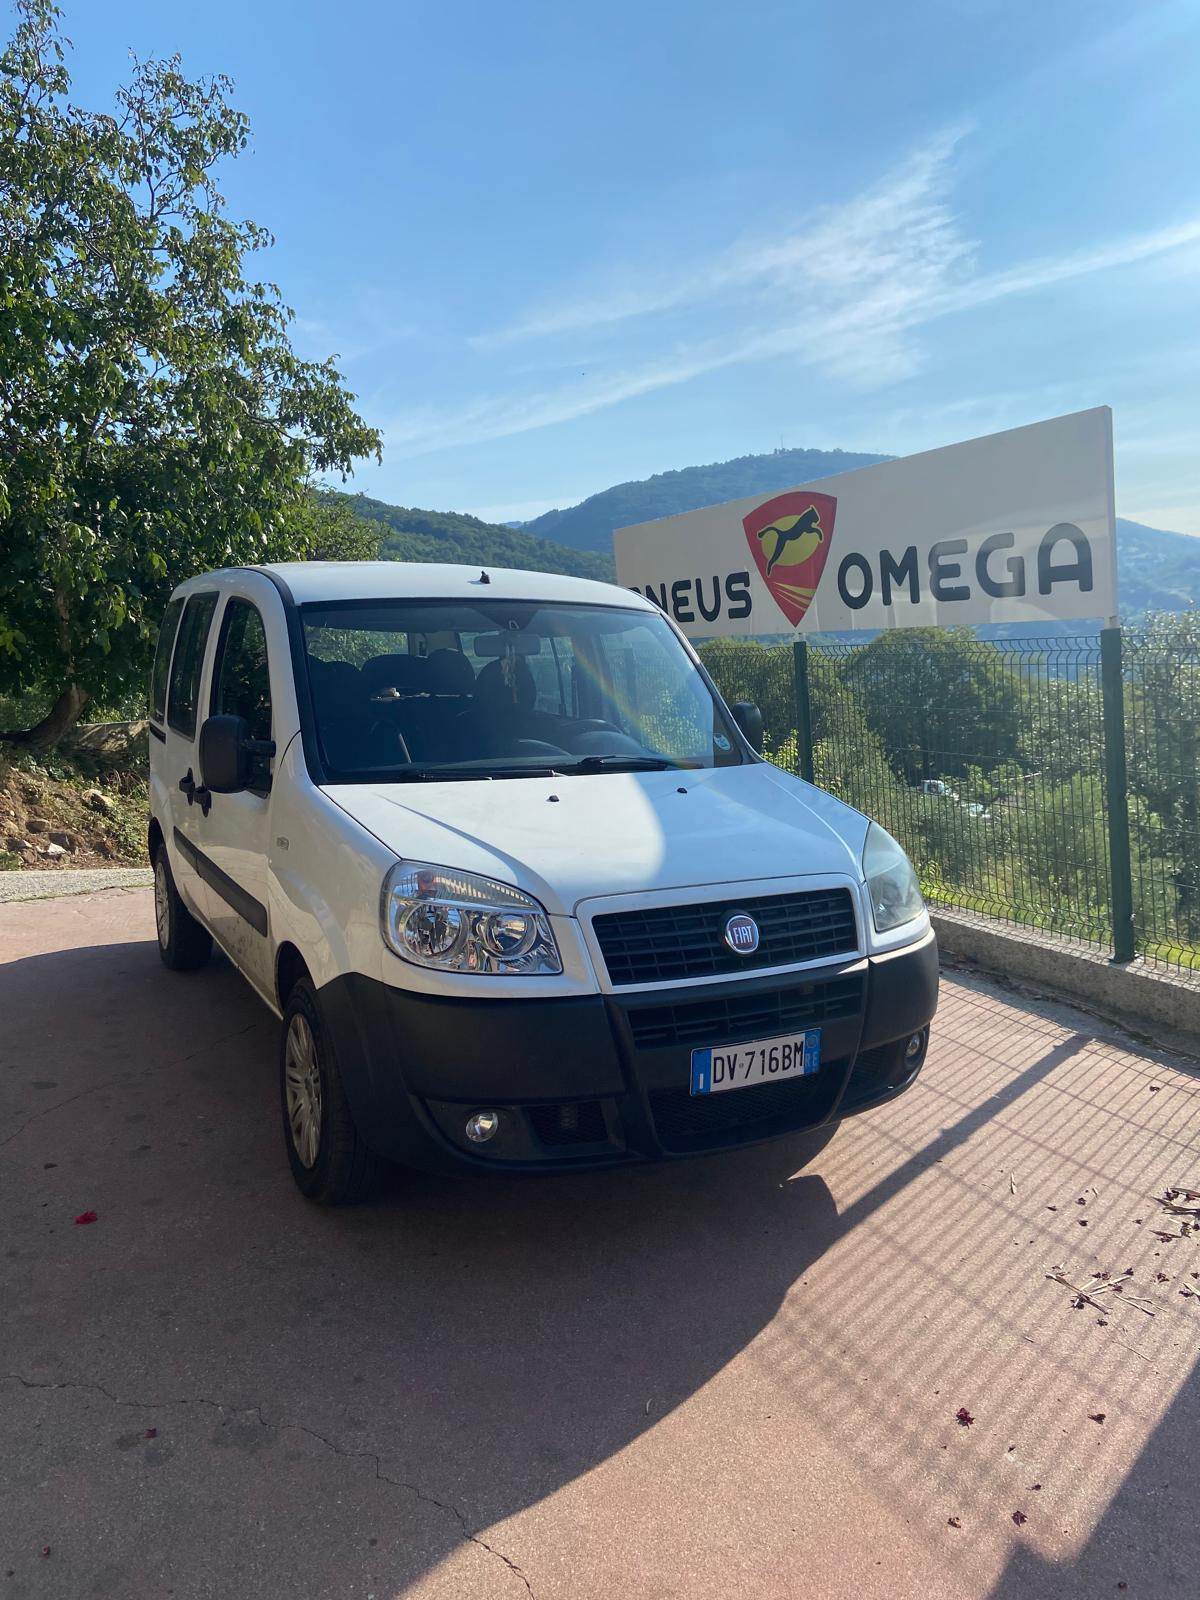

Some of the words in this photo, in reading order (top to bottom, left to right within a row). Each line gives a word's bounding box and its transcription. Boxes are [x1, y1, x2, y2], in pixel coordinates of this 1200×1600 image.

[628, 571, 752, 623] NEUS
[838, 522, 1093, 610] OMEGA
[733, 926, 752, 944] FIAT
